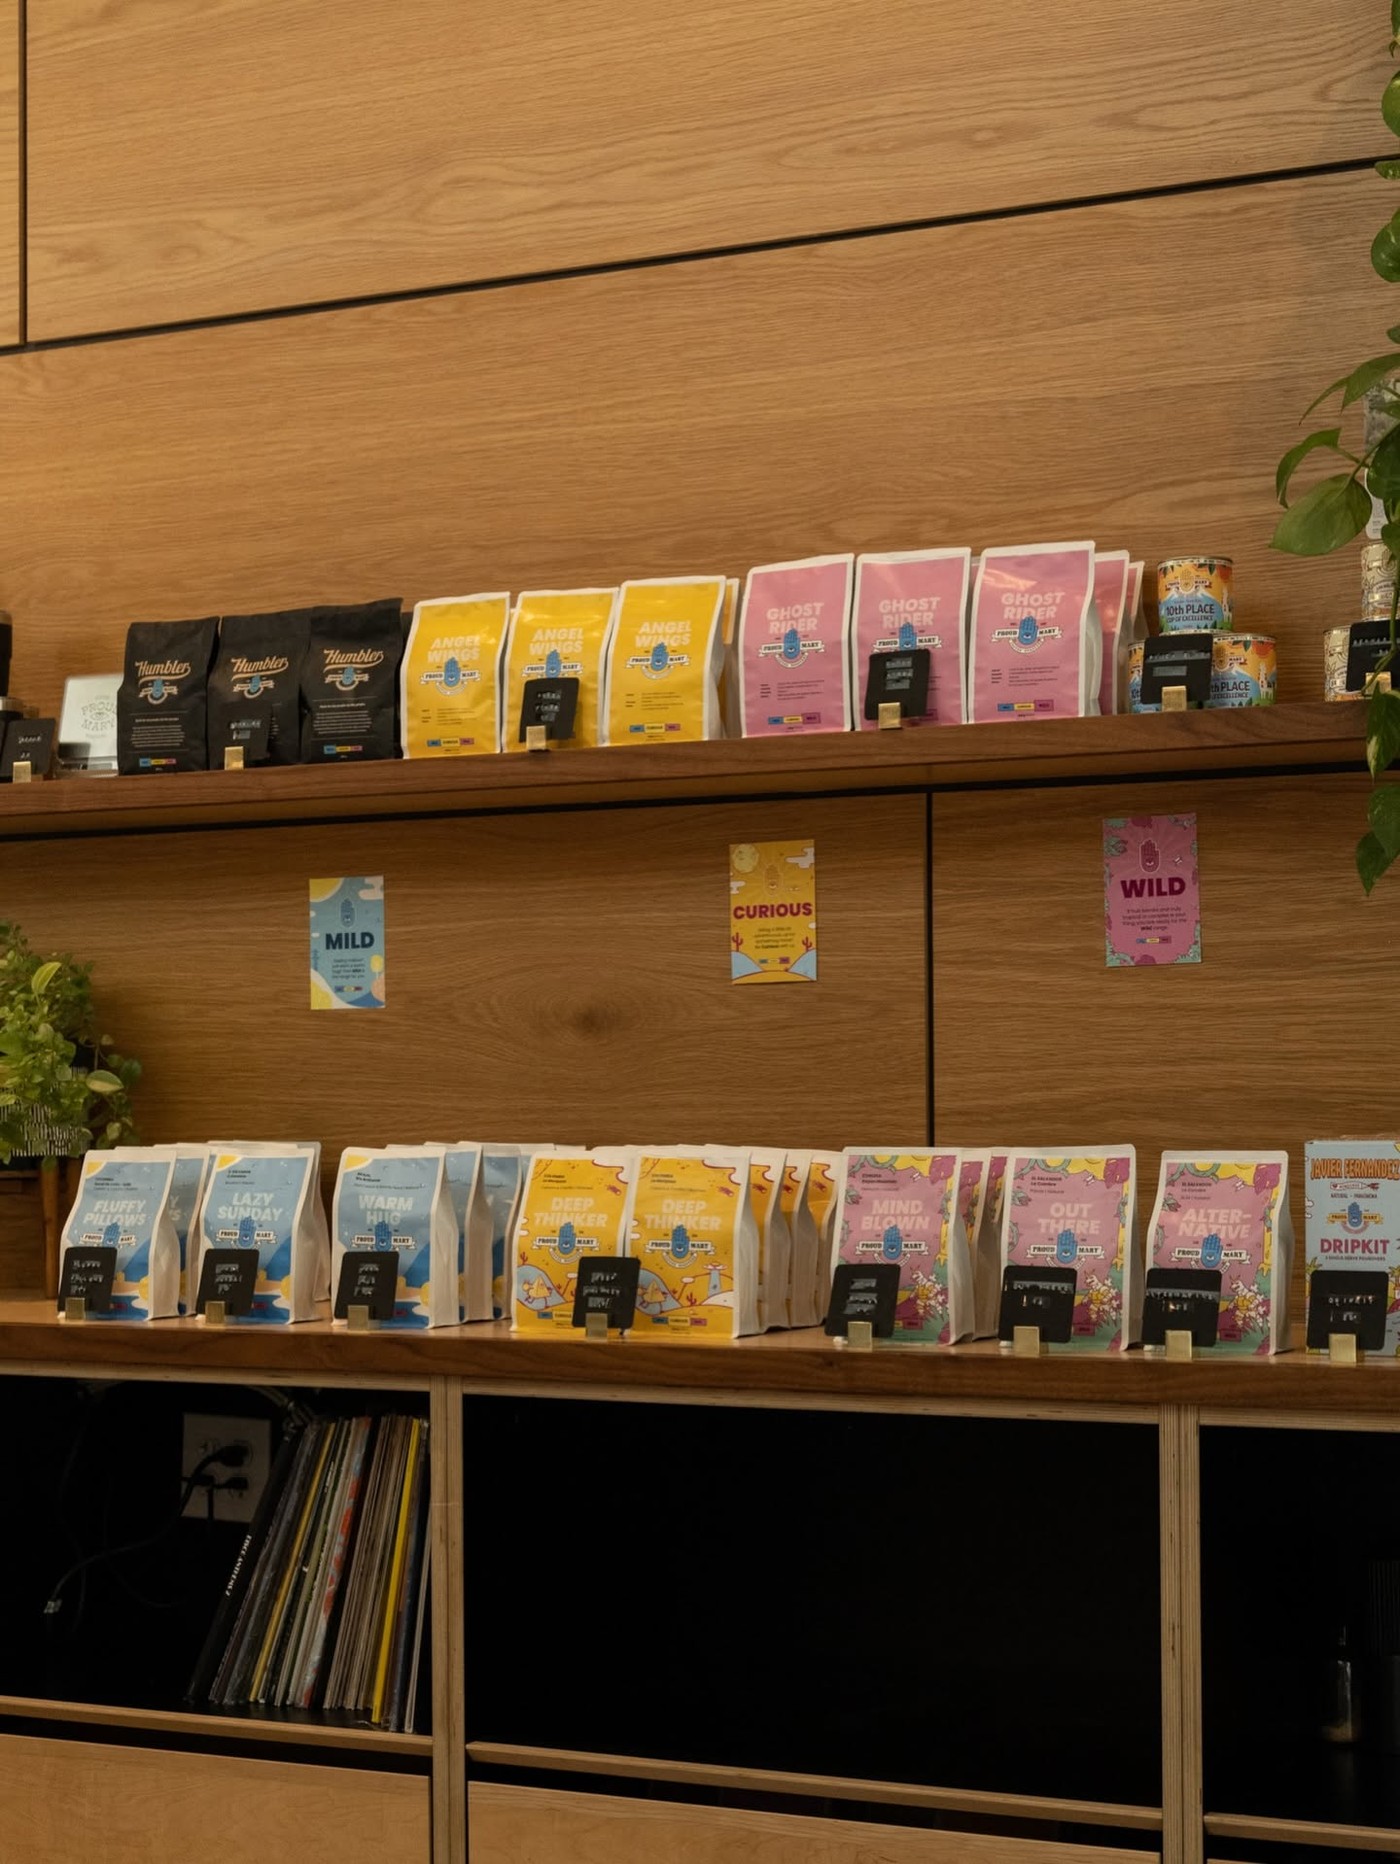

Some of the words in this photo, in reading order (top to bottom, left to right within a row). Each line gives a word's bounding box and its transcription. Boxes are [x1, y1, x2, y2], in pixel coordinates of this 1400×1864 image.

[878, 597, 941, 613] GHOST
[1001, 591, 1066, 606] GHOST
[766, 602, 825, 620] GHOST
[1003, 605, 1057, 620] RIDER
[1166, 605, 1184, 616] 10th
[1185, 603, 1215, 614] PLACE
[638, 620, 691, 634] ANGEL
[768, 617, 818, 634] RIDER
[882, 611, 934, 628] RIDER
[430, 635, 480, 649] ANGEL
[531, 627, 584, 642] ANGEL
[635, 633, 691, 648] WINGS
[427, 648, 480, 663] WINGS
[528, 641, 583, 655] WINGS
[231, 655, 289, 677] Humbler
[323, 648, 384, 668] Humbler
[134, 660, 191, 681] Humbler
[1220, 680, 1251, 692] PLACE
[1120, 876, 1186, 899] WILD
[733, 902, 813, 919] CURIOUS
[325, 932, 375, 950] MILD
[94, 1200, 146, 1212] FLUFFY
[232, 1192, 274, 1206] LAZY
[358, 1194, 414, 1211] WARM
[551, 1196, 595, 1212] DEEP
[662, 1199, 708, 1214] DEEP
[871, 1199, 923, 1215] MIND
[217, 1206, 284, 1221] SUNDAY
[366, 1210, 401, 1226] HUG
[1050, 1202, 1093, 1218] OUT
[1182, 1208, 1252, 1224] ALTER-
[83, 1212, 147, 1226] PILLOWS
[534, 1212, 608, 1228] THINKER
[643, 1213, 722, 1230] THINKER
[860, 1215, 931, 1230] BLOWN
[1038, 1218, 1102, 1235] THERE
[1178, 1222, 1251, 1239] NATIVE
[1320, 1238, 1390, 1254] DRIPKIT
